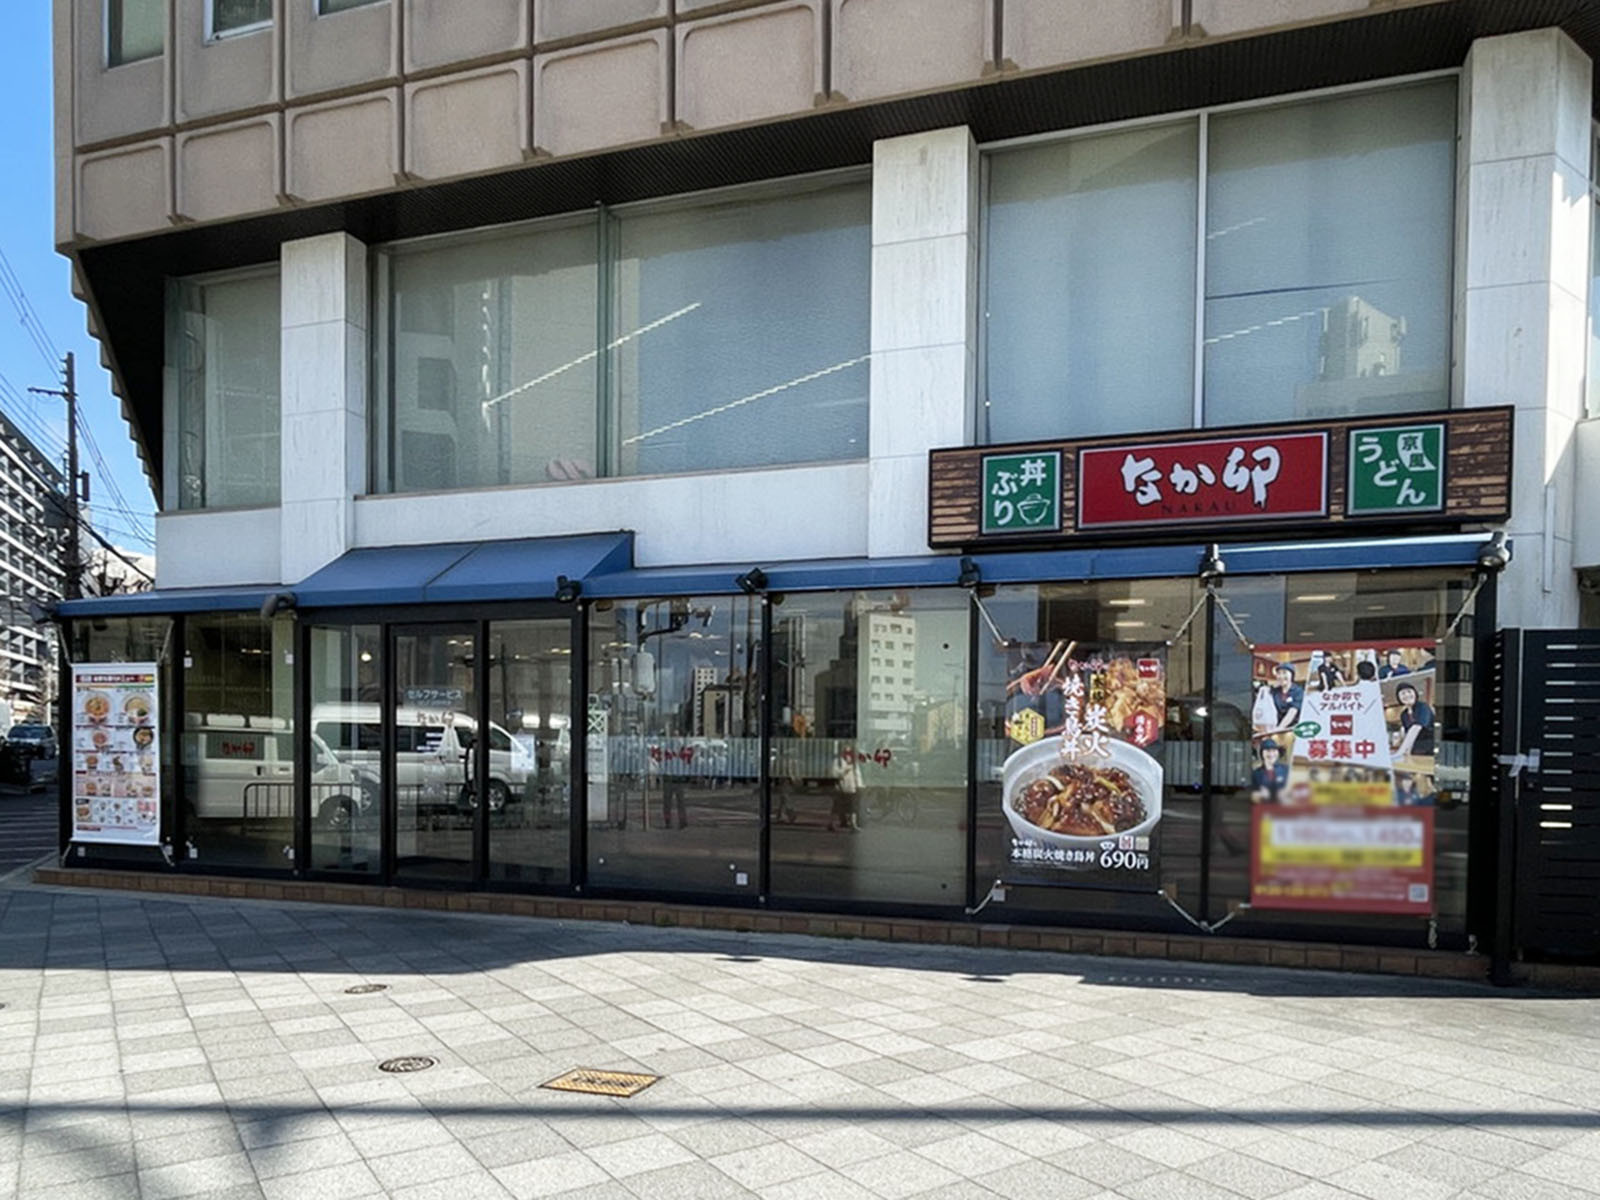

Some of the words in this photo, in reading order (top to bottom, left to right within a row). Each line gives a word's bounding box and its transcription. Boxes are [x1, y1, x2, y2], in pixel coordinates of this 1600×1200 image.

[1402, 436, 1426, 468] 京風
[1120, 445, 1281, 509] なか卯
[1358, 436, 1426, 505] うどん
[991, 459, 1047, 526] 丼ぶり
[1161, 500, 1237, 515] NAKAU
[1320, 702, 1364, 711] アルバイト
[1308, 739, 1375, 759] 募集中
[1100, 851, 1149, 870] 690円
